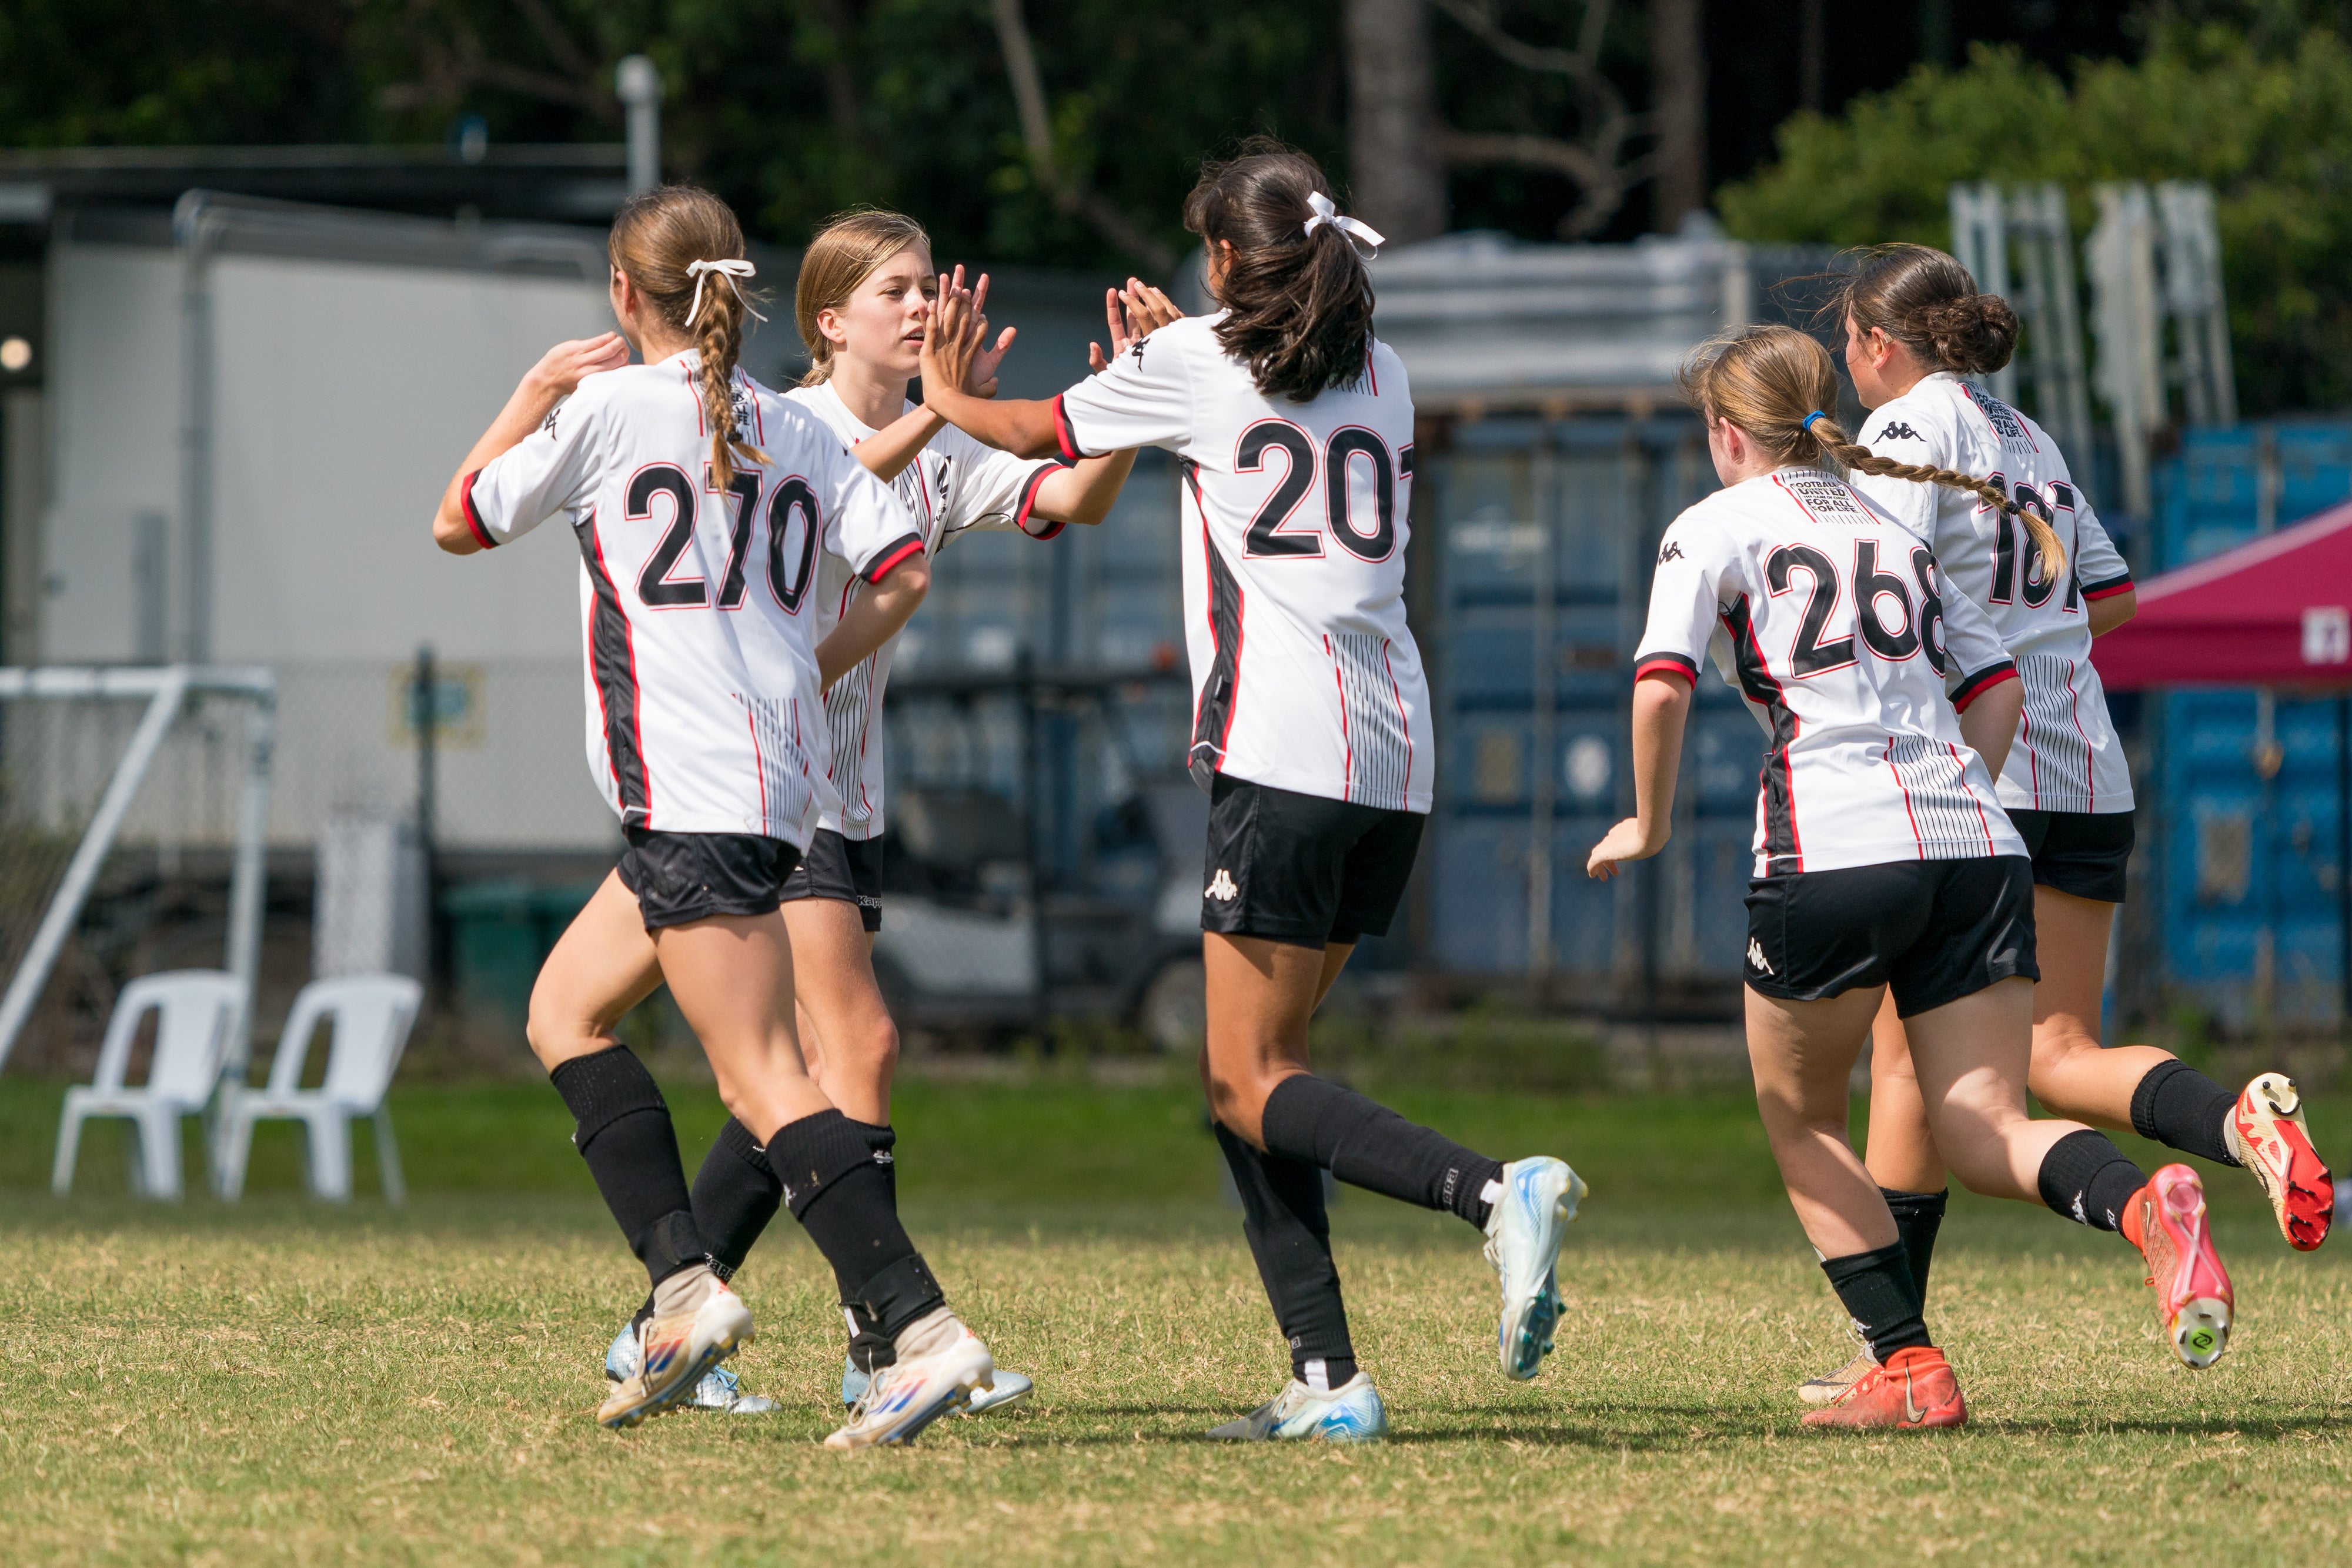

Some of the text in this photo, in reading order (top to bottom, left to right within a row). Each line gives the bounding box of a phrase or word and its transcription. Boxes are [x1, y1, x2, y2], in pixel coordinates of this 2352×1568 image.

[624, 462, 821, 616] 270
[1764, 539, 1946, 678] 268
[857, 895, 882, 908] Kapp
